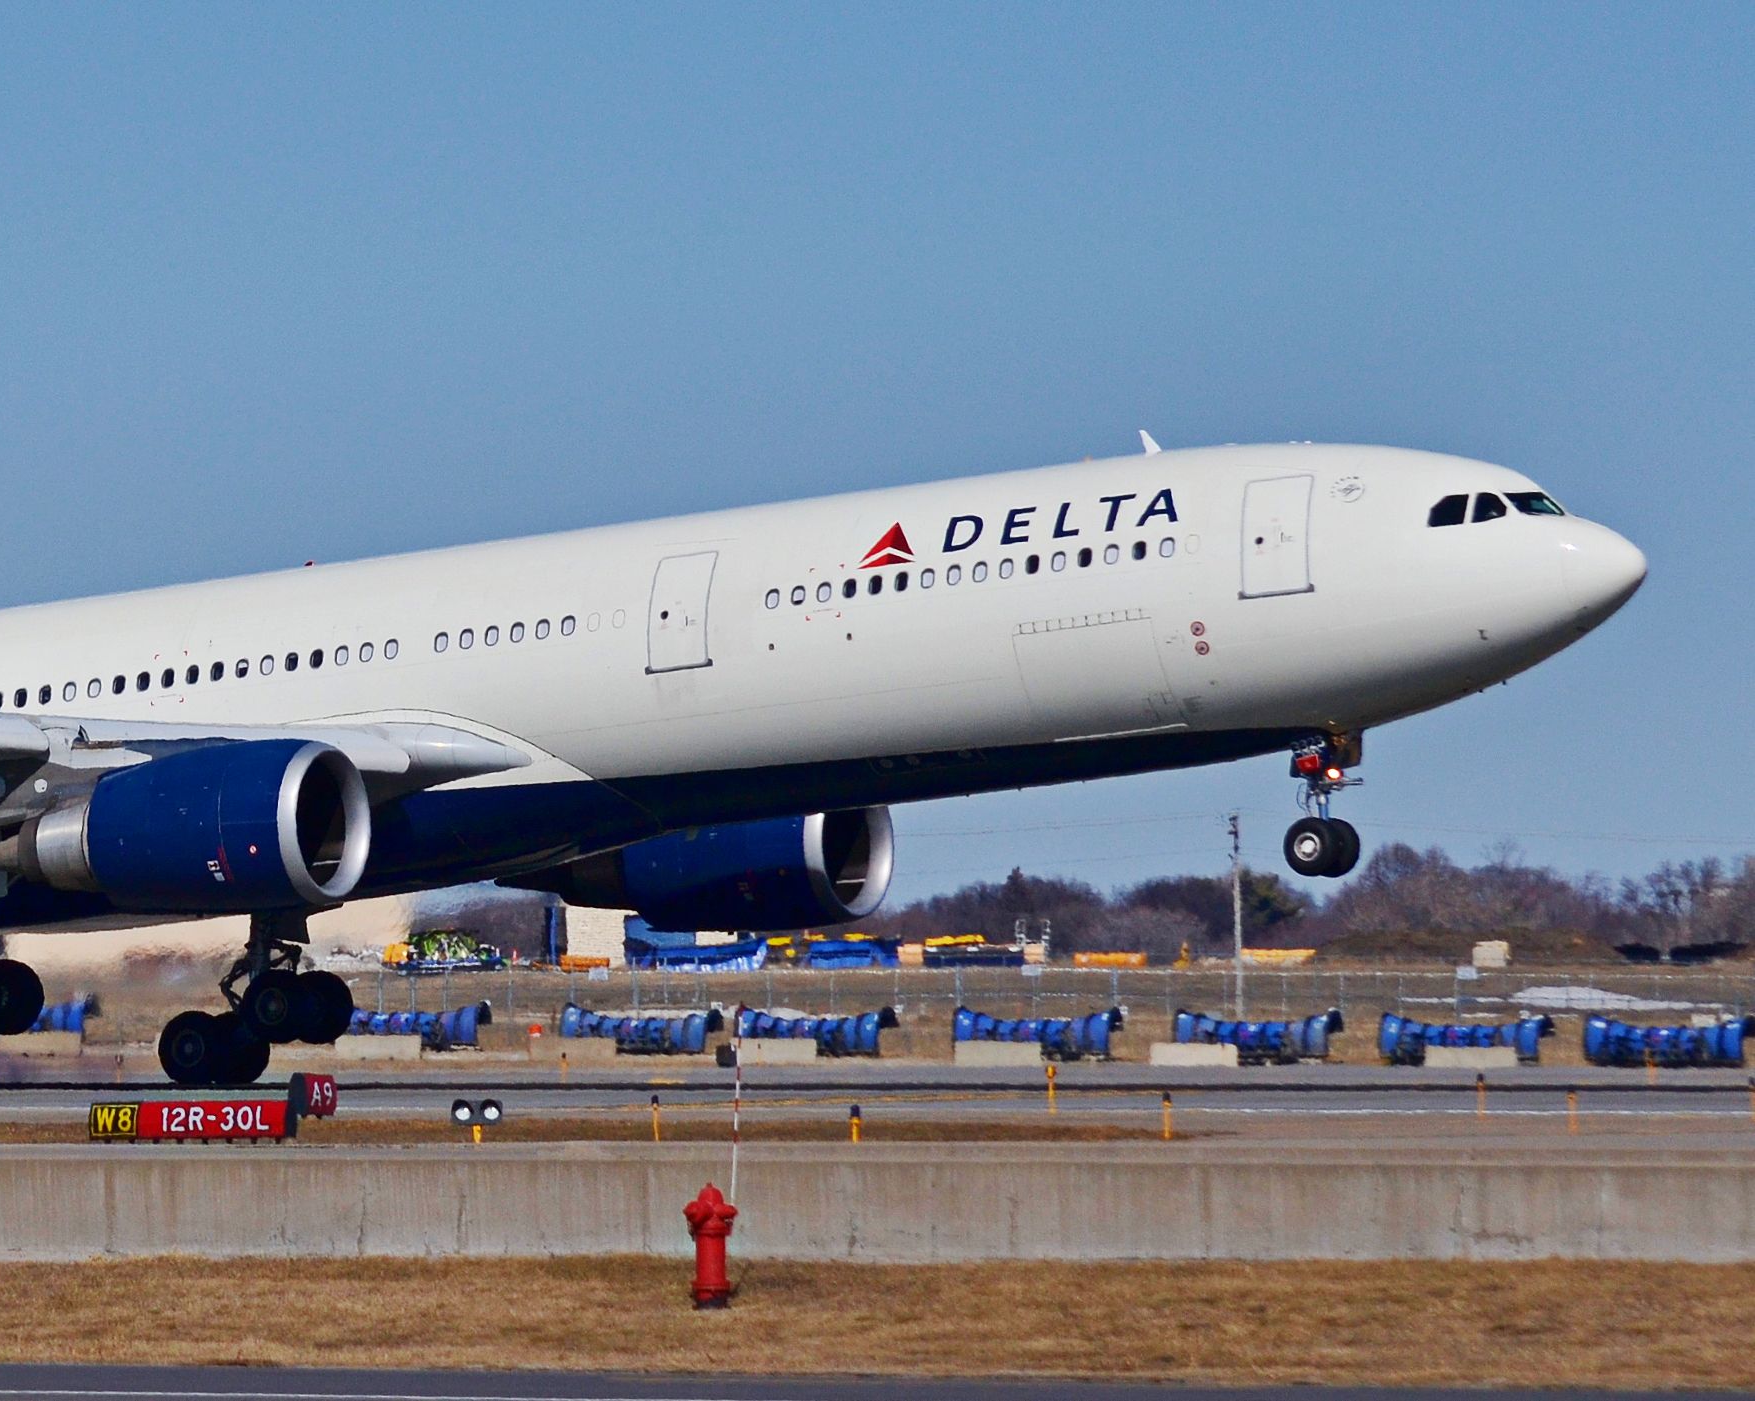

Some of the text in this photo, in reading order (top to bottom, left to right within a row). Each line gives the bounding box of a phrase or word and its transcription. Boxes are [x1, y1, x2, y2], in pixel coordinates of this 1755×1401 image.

[942, 488, 1179, 553] DELTA
[310, 1081, 333, 1106] A9
[96, 1105, 270, 1133] W8 12R-30L
